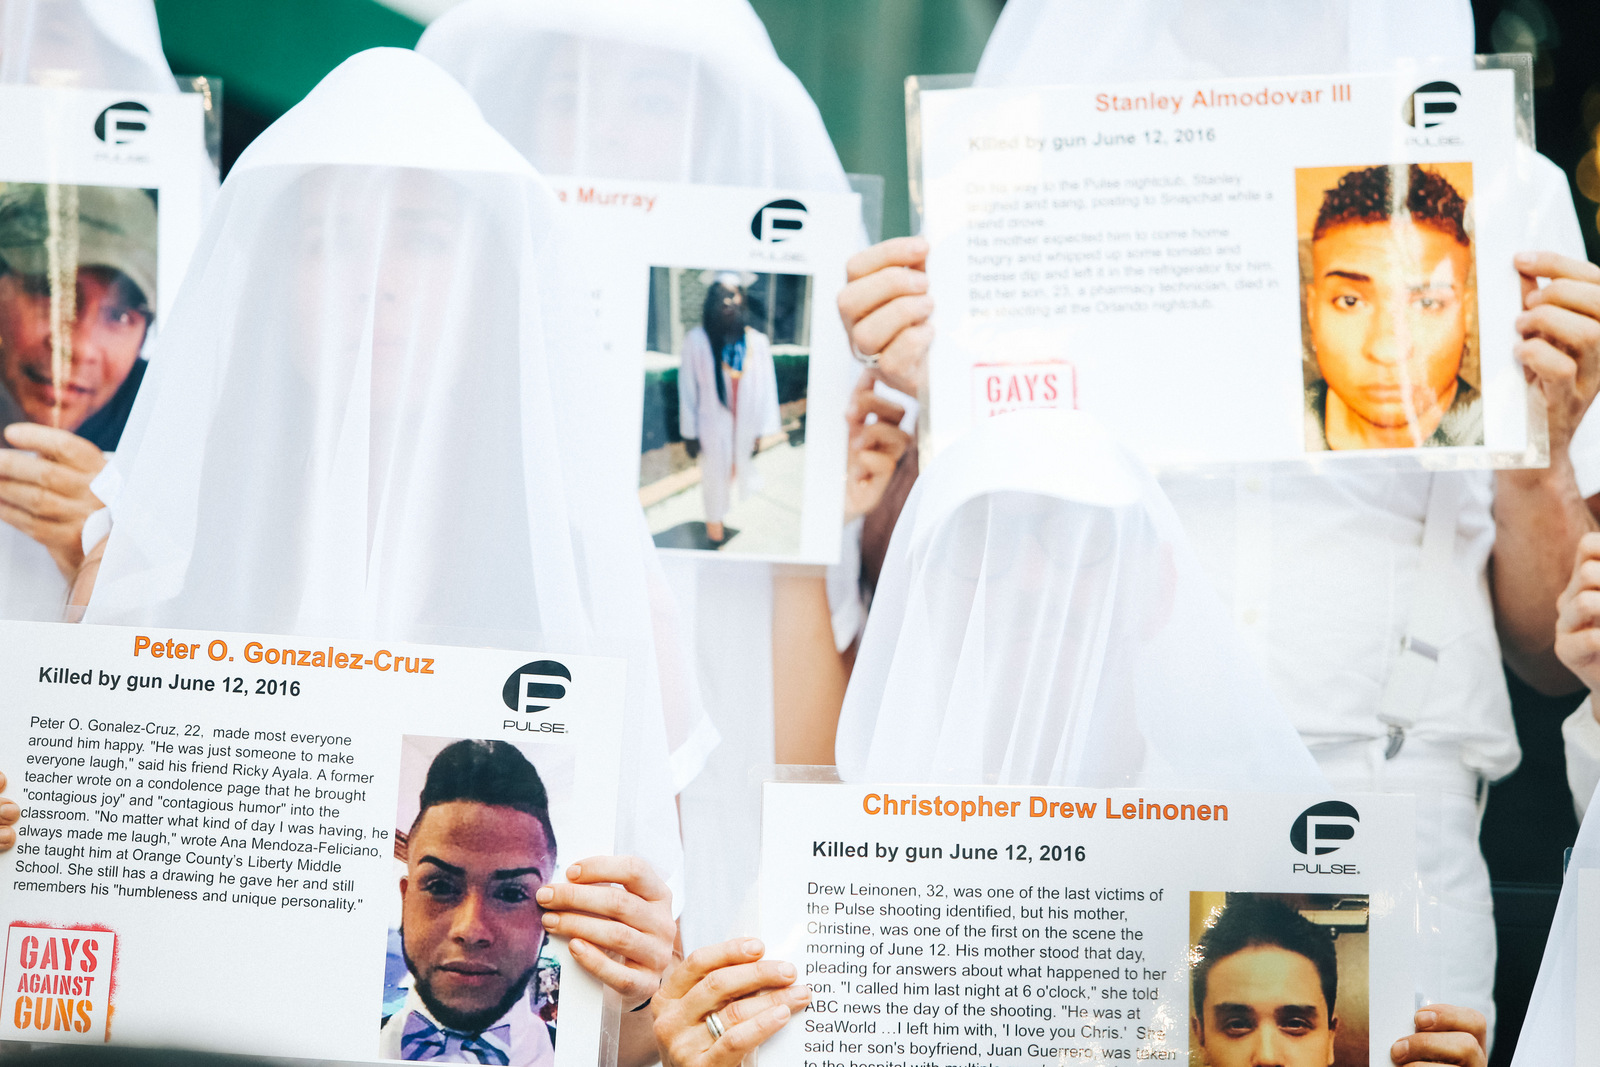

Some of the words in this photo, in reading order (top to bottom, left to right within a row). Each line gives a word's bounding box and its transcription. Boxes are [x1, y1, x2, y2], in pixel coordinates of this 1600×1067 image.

[1096, 92, 1182, 114] Stanley
[1192, 88, 1322, 108] Almodovar
[1332, 84, 1350, 102] III
[1052, 136, 1087, 152] gun
[1091, 131, 1136, 148] June
[1174, 127, 1216, 144] 2016
[578, 187, 656, 212] Murray
[986, 374, 1057, 402] GAYS
[134, 636, 200, 660] Peter
[208, 640, 234, 662] O.
[244, 642, 434, 674] Gonzalez-Cruz
[39, 667, 92, 685] Killed
[99, 670, 121, 690] by
[127, 676, 162, 691] gun
[168, 674, 215, 691] June
[223, 677, 248, 696] 12,
[255, 679, 300, 696] 2016
[30, 716, 65, 729] Peter
[69, 718, 82, 730] O.
[88, 719, 178, 737] Gonalez-Cruz,
[184, 724, 203, 738] 22,
[213, 728, 250, 739] made
[254, 731, 286, 742] most
[290, 734, 352, 747] everyone
[28, 736, 73, 748] around
[77, 737, 100, 749] him
[104, 738, 144, 754] happy.
[151, 741, 174, 753] "He
[178, 745, 204, 755] was
[207, 744, 231, 758] just
[235, 748, 296, 760] someone
[301, 750, 313, 762] to
[318, 752, 354, 764] make
[27, 755, 85, 768] everyone
[90, 756, 134, 771] laugh,"
[138, 759, 164, 771] said
[169, 760, 186, 772] his
[192, 761, 228, 774] friend
[233, 764, 269, 780] Ricky
[272, 766, 312, 781] Ayala.
[317, 769, 326, 780] A
[331, 770, 374, 783] former
[25, 771, 73, 784] teacher
[77, 775, 112, 786] wrote
[116, 778, 131, 787] on
[136, 779, 143, 788] a
[148, 778, 222, 792] condolence
[227, 784, 260, 797] page
[265, 784, 290, 796] that
[294, 786, 310, 798] he
[315, 787, 366, 804] brought
[24, 788, 97, 805] "contagious
[100, 792, 125, 808] joy"
[129, 795, 153, 806] and
[158, 796, 234, 813] "contagious
[239, 800, 286, 814] humor"
[291, 804, 314, 816] into
[320, 806, 340, 818] the
[863, 794, 1021, 822] Christopher
[1030, 796, 1097, 818] Drew
[1106, 798, 1228, 821] Leinonen
[20, 806, 89, 821] classroom.
[95, 810, 118, 823] "No
[122, 814, 164, 825] matter
[168, 815, 198, 828] what
[203, 816, 230, 829] kind
[234, 818, 248, 830] of
[251, 820, 275, 835] day
[280, 821, 283, 832] I
[288, 824, 314, 834] was
[319, 824, 366, 840] having,
[372, 827, 388, 839] he
[813, 841, 868, 858] Killed
[876, 842, 898, 862] by
[906, 847, 942, 862] gun
[950, 844, 998, 860] June
[1006, 844, 1032, 864] 12,
[1040, 845, 1085, 862] 2016
[14, 881, 86, 894] remembers
[91, 882, 109, 895] his
[114, 884, 198, 900] "humbleness
[202, 890, 227, 902] and
[232, 892, 276, 907] unique
[282, 897, 363, 913] personality."
[808, 882, 845, 895] Drew
[850, 883, 920, 898] Leinonen,
[927, 884, 948, 899] 32,
[954, 888, 982, 898] was
[987, 888, 1014, 898] one
[1019, 886, 1034, 898] of
[1037, 886, 1060, 899] the
[1065, 887, 1090, 900] last
[1094, 888, 1144, 901] victims
[1150, 888, 1164, 901] of
[807, 902, 829, 914] the
[835, 902, 874, 916] Pulse
[880, 904, 940, 920] shooting
[946, 904, 1015, 920] identified,
[1021, 906, 1043, 919] but
[1048, 906, 1068, 919] his
[1074, 907, 1127, 922] mother,
[808, 922, 874, 936] Christine,
[880, 926, 908, 936] was
[914, 926, 940, 936] one
[946, 924, 960, 937] of
[964, 924, 986, 937] the
[991, 924, 1018, 938] first
[1022, 928, 1040, 938] on
[1045, 926, 1067, 939] the
[1072, 930, 1116, 940] scene
[1121, 928, 1143, 940] the
[20, 935, 98, 973] GAYS
[807, 942, 864, 958] morning
[870, 942, 884, 955] of
[888, 943, 923, 956] June
[930, 944, 950, 956] 12.
[956, 944, 979, 957] His
[984, 945, 1035, 958] mother
[1040, 946, 1079, 959] stood
[1084, 946, 1112, 960] that
[1116, 947, 1144, 963] day,
[17, 973, 95, 996] AGAINST
[806, 961, 867, 978] pleading
[872, 962, 891, 975] for
[896, 966, 956, 976] answers
[962, 964, 1003, 977] about
[1007, 965, 1042, 978] what
[1047, 965, 1119, 982] happened
[1124, 968, 1138, 980] to
[1143, 968, 1166, 980] her
[14, 995, 93, 1033] GUNS
